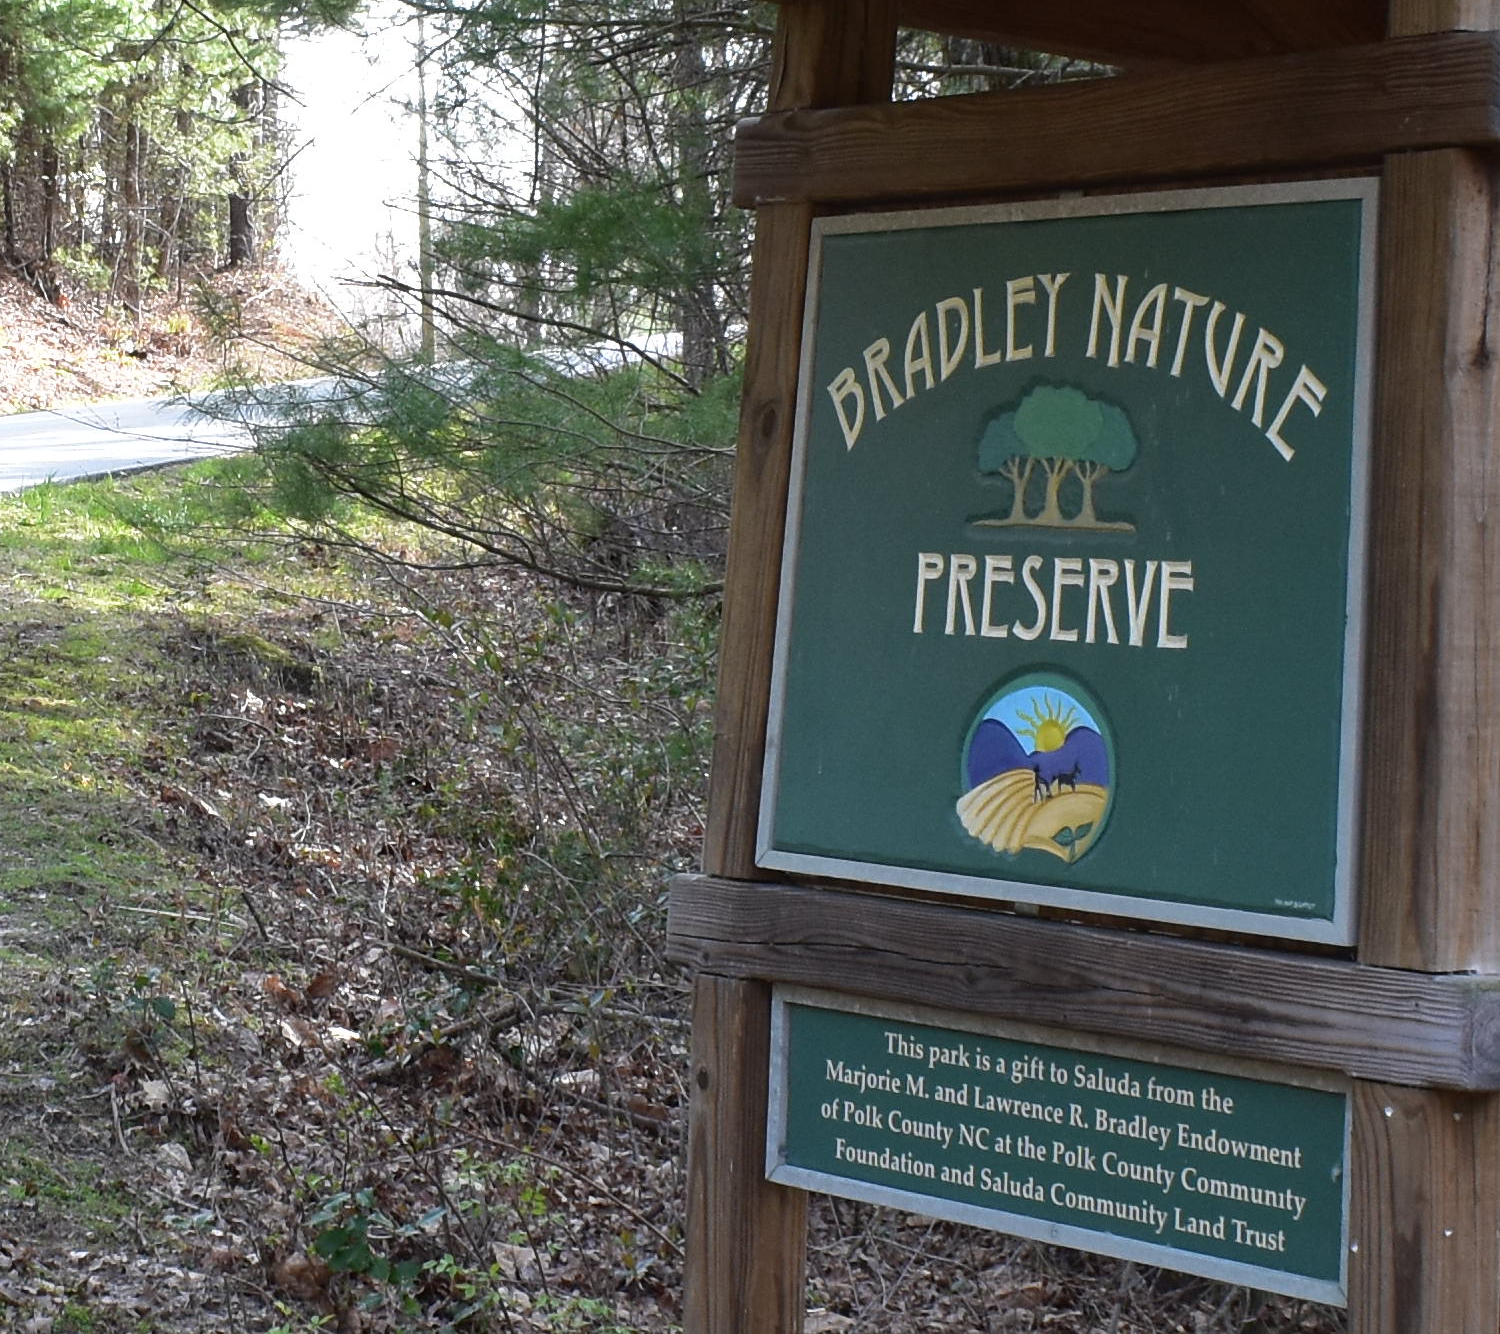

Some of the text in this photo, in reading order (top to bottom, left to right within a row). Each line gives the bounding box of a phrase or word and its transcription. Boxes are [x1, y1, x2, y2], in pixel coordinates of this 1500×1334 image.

[826, 271, 1327, 462] BRADLEY NATURE
[912, 552, 1194, 649] PRESERVE
[826, 1059, 1303, 1169] Marjorie M. and Lawrence R. Bradley Endowment
[884, 1031, 1234, 1115] This park is a gift to Saluda from the
[821, 1098, 1307, 1220] of Polk County NC at the Polk County Community
[835, 1137, 1286, 1253] Foundation and Saluda Community Land Trust
